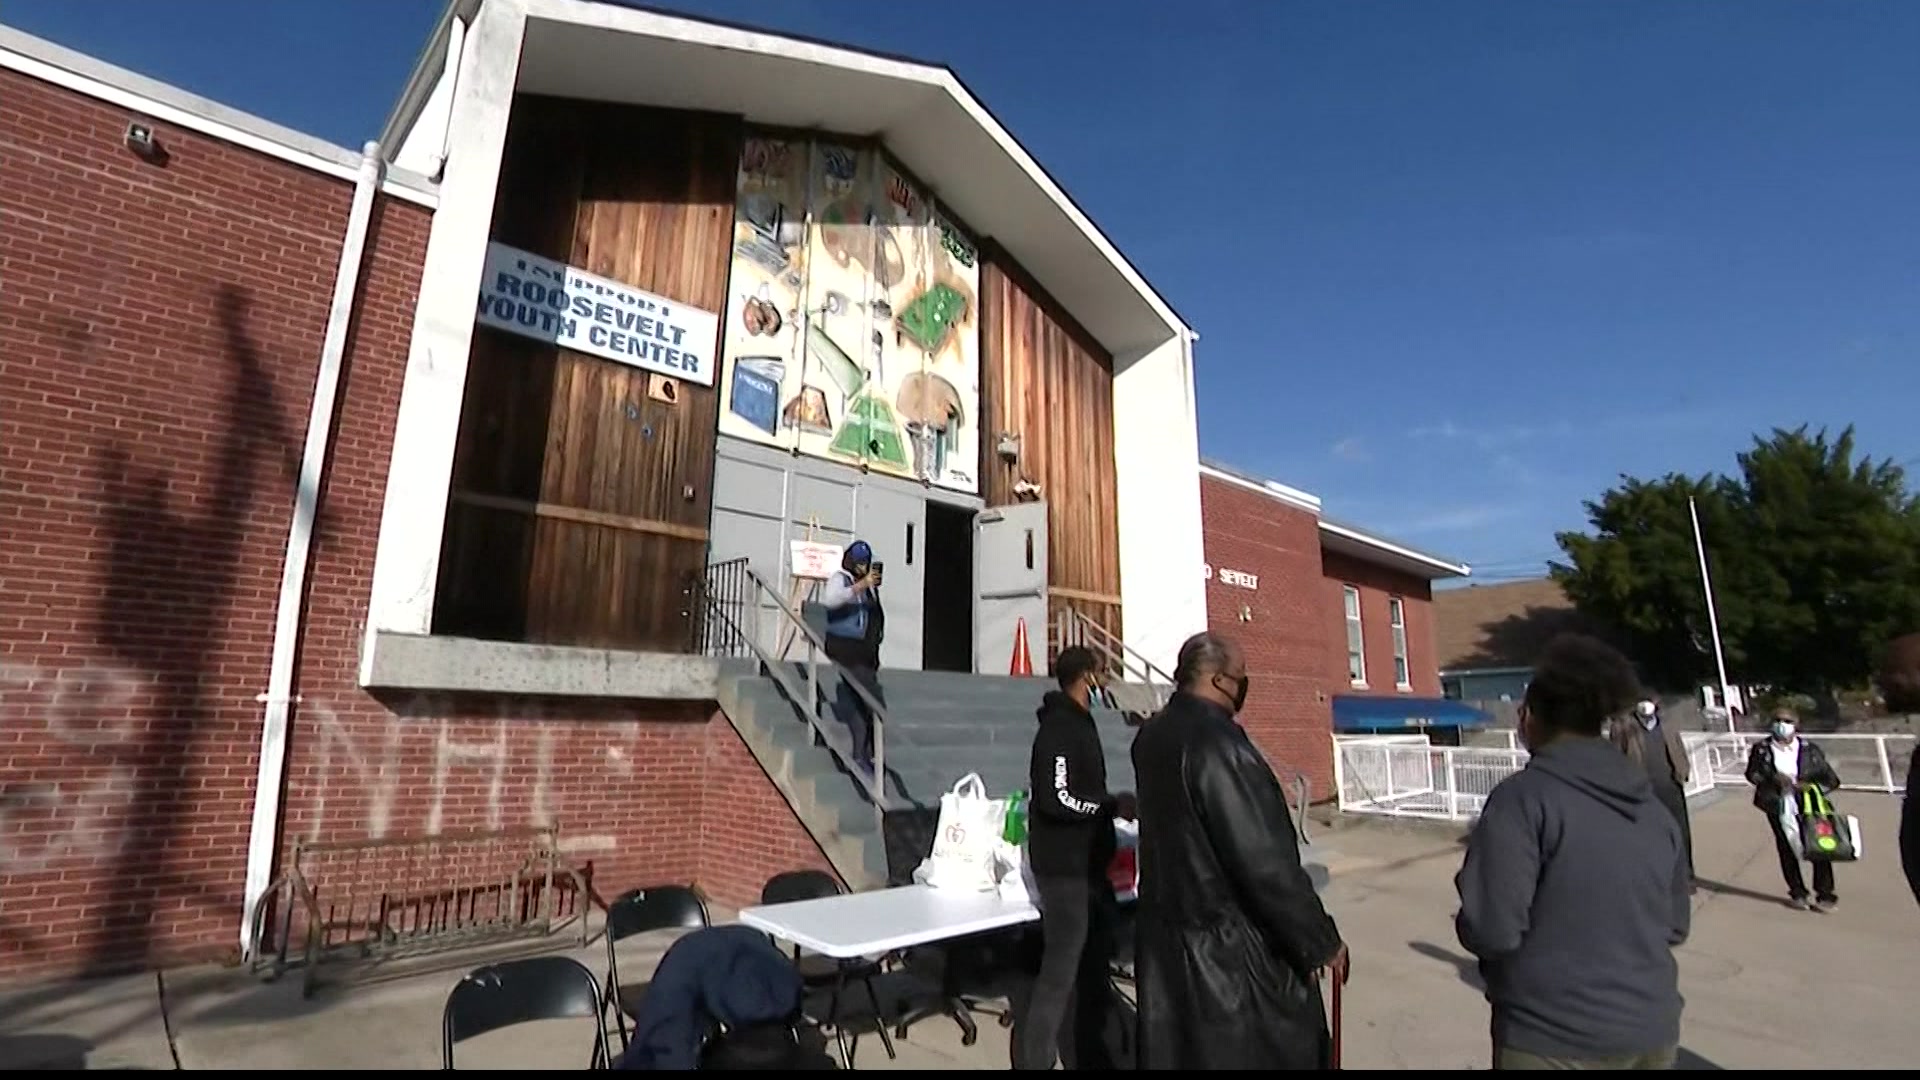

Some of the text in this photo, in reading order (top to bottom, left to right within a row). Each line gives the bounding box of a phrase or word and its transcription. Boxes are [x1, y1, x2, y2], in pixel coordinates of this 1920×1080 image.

[479, 291, 699, 375] YOUTH CENTER
[496, 271, 687, 347] ROOSEVELT
